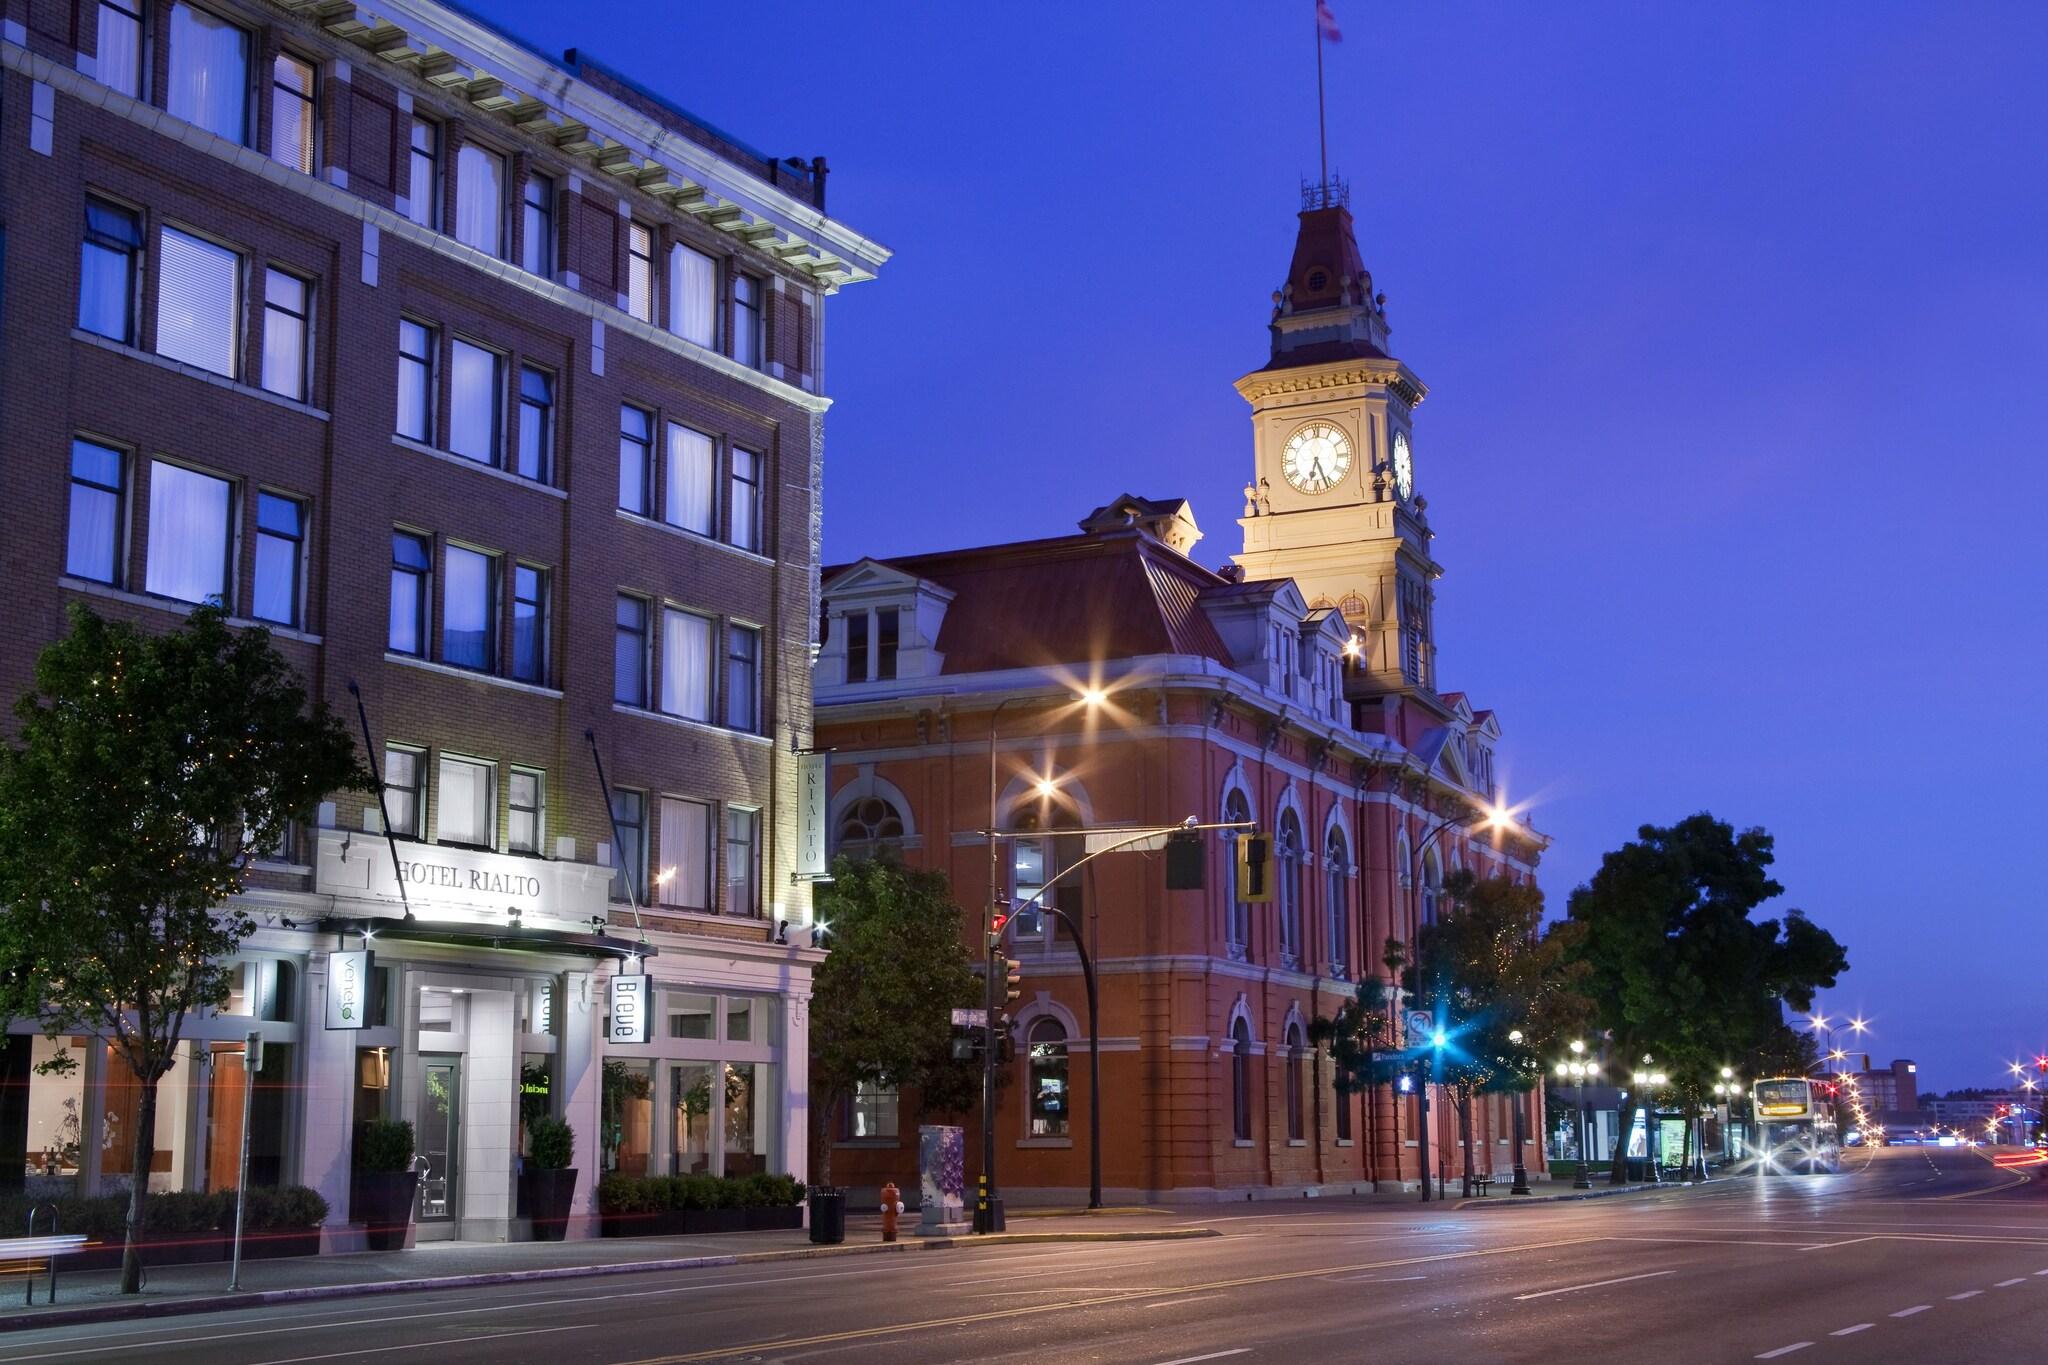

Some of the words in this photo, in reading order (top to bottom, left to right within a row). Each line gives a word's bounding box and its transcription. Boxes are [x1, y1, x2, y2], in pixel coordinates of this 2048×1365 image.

[805, 772, 817, 862] RIALTO
[394, 860, 464, 889] HOTEL
[468, 868, 541, 898] RIALTO
[615, 982, 639, 1037] Brevé
